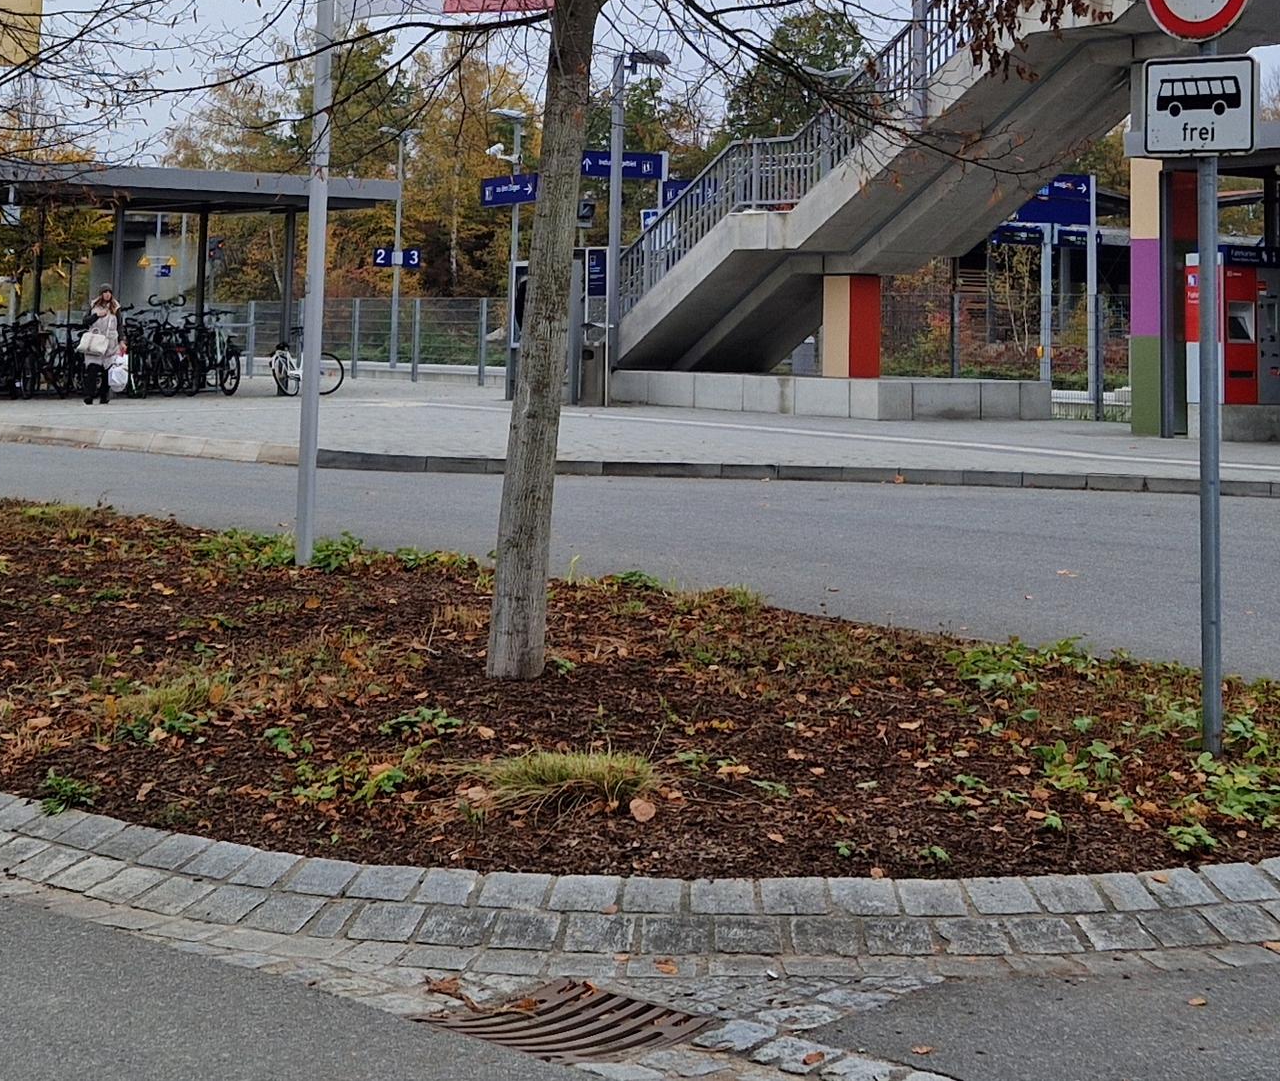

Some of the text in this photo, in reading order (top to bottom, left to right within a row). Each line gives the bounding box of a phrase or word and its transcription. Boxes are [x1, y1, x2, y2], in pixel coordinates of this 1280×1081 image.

[1182, 122, 1215, 142] frei
[375, 249, 419, 265] 2 3
